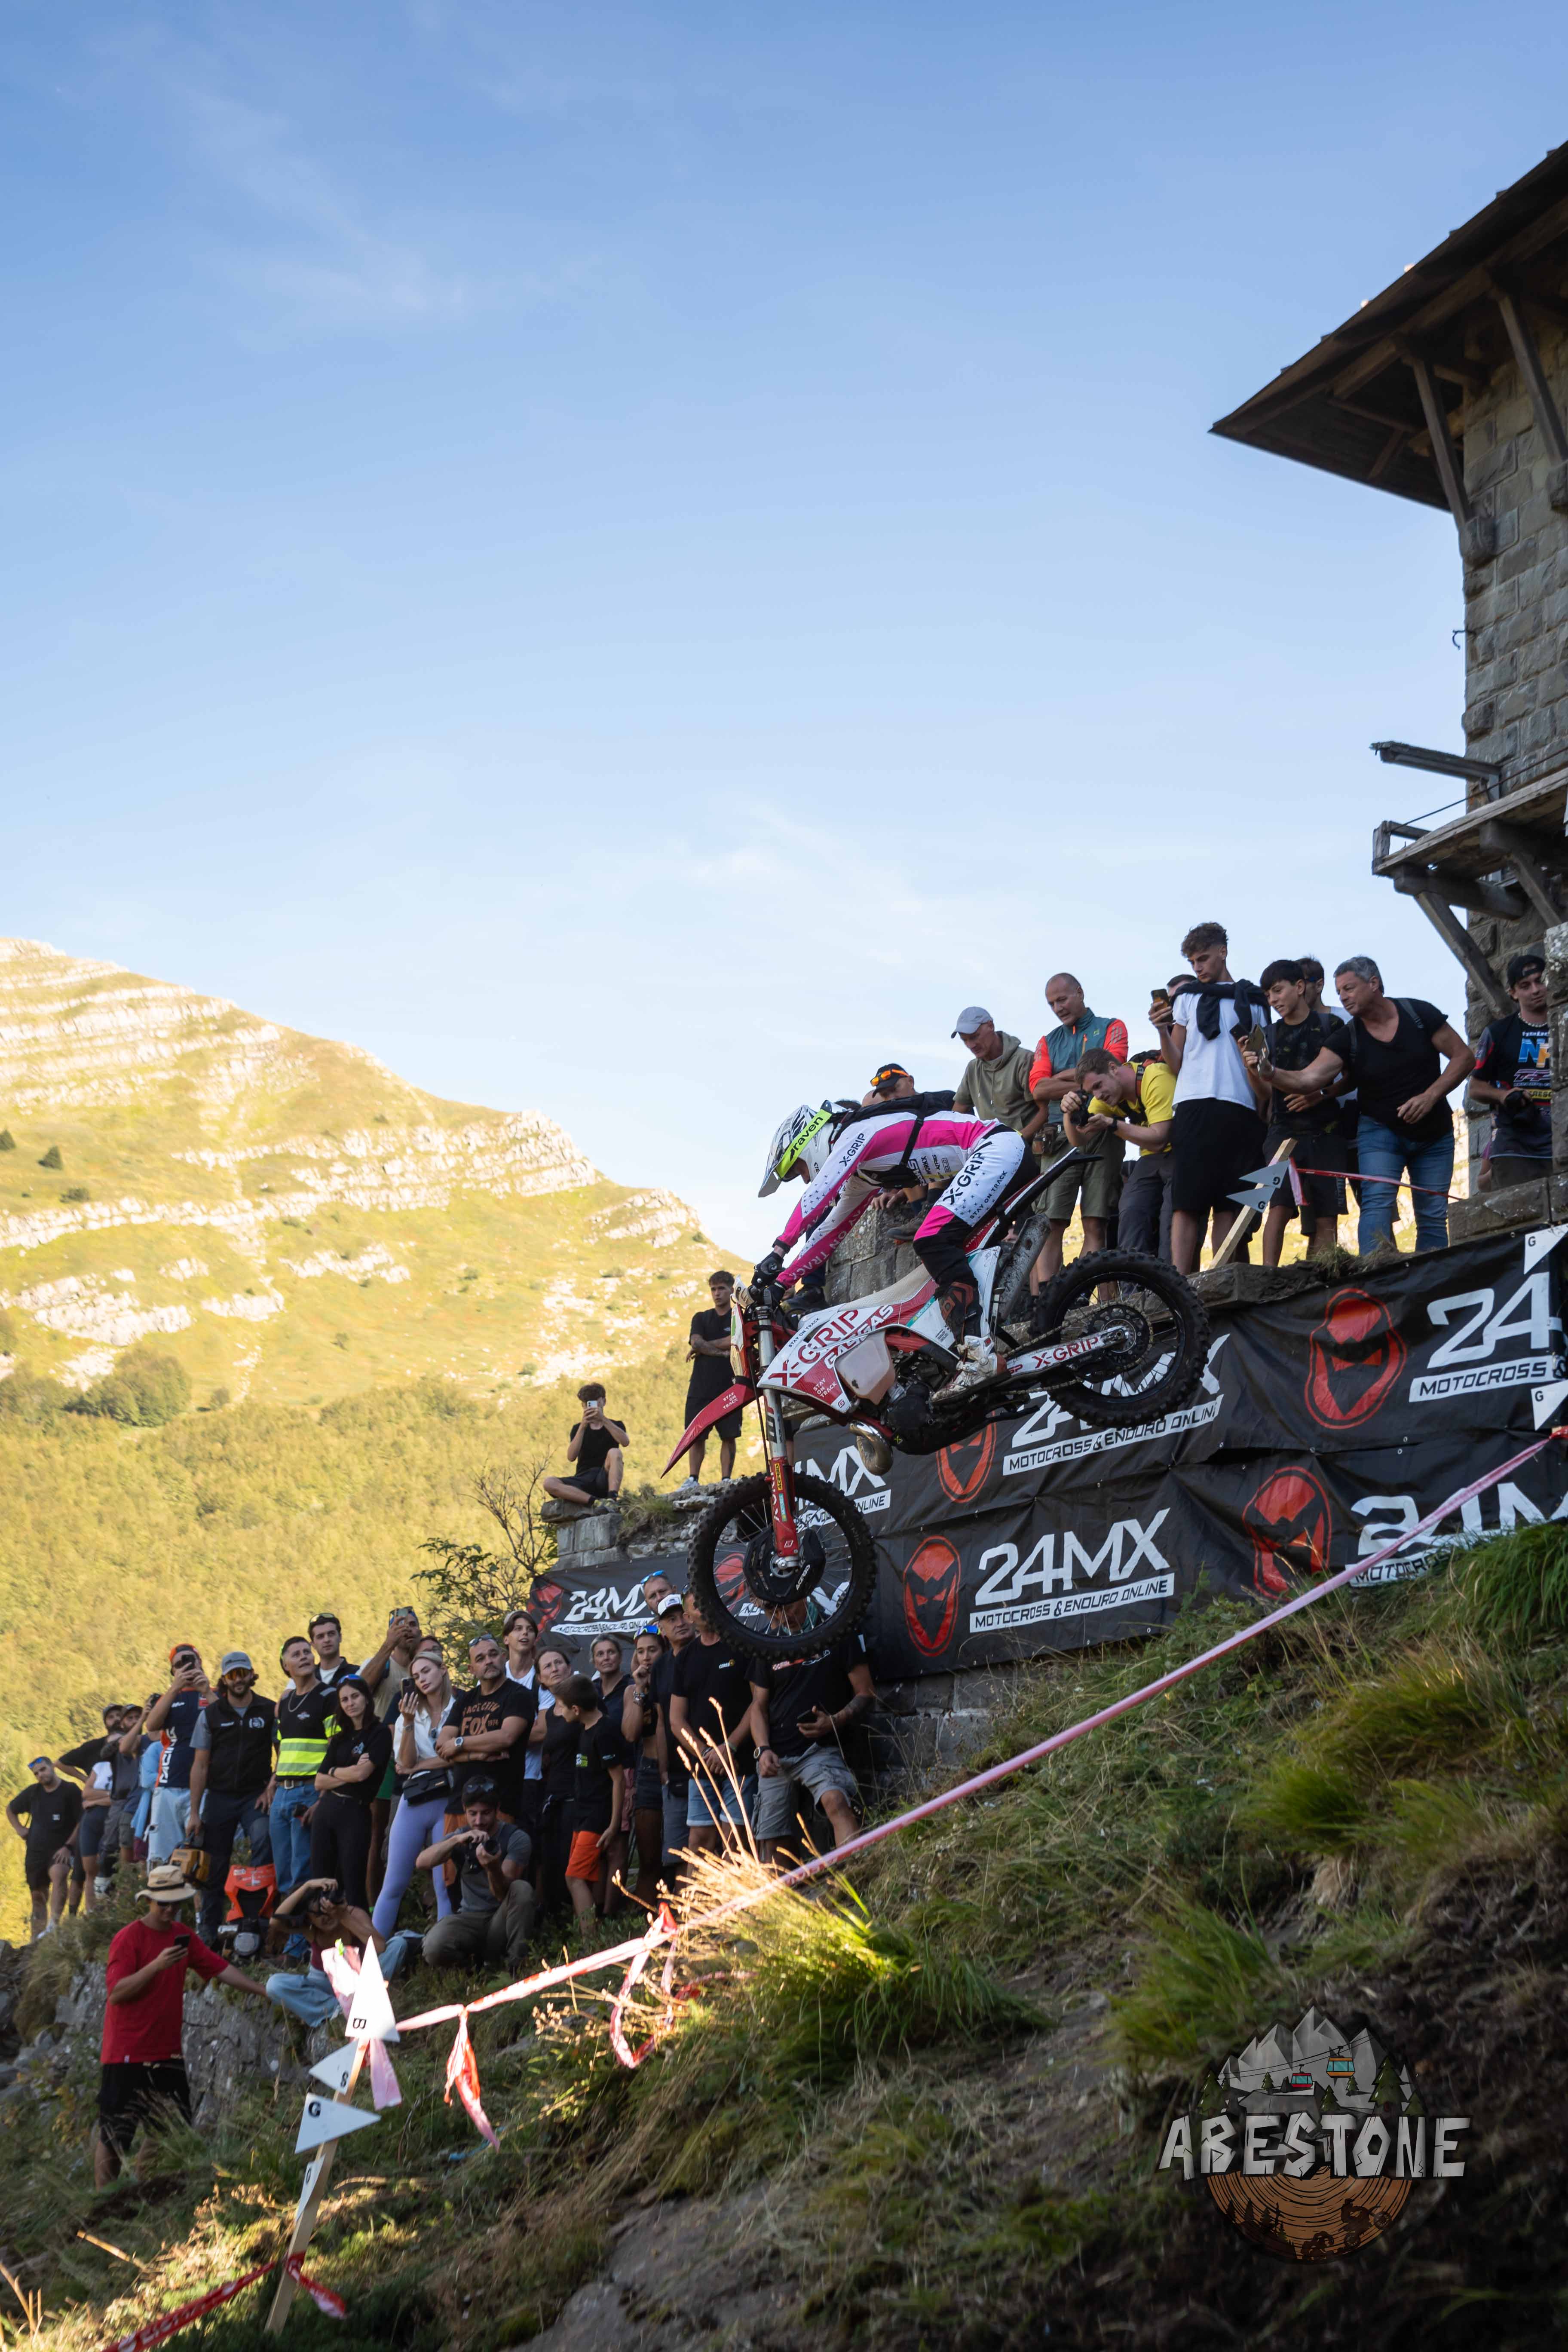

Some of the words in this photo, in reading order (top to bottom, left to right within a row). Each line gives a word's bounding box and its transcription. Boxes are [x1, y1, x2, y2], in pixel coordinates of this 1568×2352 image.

[839, 1133, 865, 1167] X-GRIP
[943, 1152, 985, 1205] X-GRIP
[970, 1204, 983, 1219] STAY
[984, 1194, 992, 1204] ON
[991, 1170, 1008, 1192] TRACK
[1258, 1201, 1266, 1210] G
[829, 1231, 847, 1249] ON
[1528, 1236, 1536, 1247] G
[789, 1251, 830, 1280] TRACK
[1427, 1271, 1550, 1369] 24
[788, 1336, 799, 1348] STAY
[805, 1318, 820, 1330] TRACK
[768, 1310, 859, 1387] X-GRIP
[1032, 1337, 1098, 1369] X-GRIP
[813, 1378, 826, 1391] STAY
[1419, 1362, 1547, 1396] MOTOCROSS
[723, 1392, 734, 1401] STAY
[817, 1386, 825, 1395] ON
[821, 1382, 837, 1398] TRACK
[1535, 1391, 1544, 1402] G
[723, 1398, 738, 1409] TRACK
[1009, 1439, 1091, 1470] MOTOCROSS
[1093, 1435, 1102, 1450] &
[1104, 1421, 1166, 1446] ENDURO
[859, 1495, 885, 1512] NLINE
[975, 1507, 1170, 1606] 24MX
[975, 1604, 1050, 1628] MOTOCROSS
[1054, 1601, 1062, 1617] &
[1063, 1591, 1119, 1612] ENDURO
[1121, 1580, 1168, 1602] ONLINE
[628, 1620, 648, 1629] ONLIN
[461, 1713, 490, 1736] FOX
[352, 2018, 367, 2029] B
[308, 2101, 321, 2117] G
